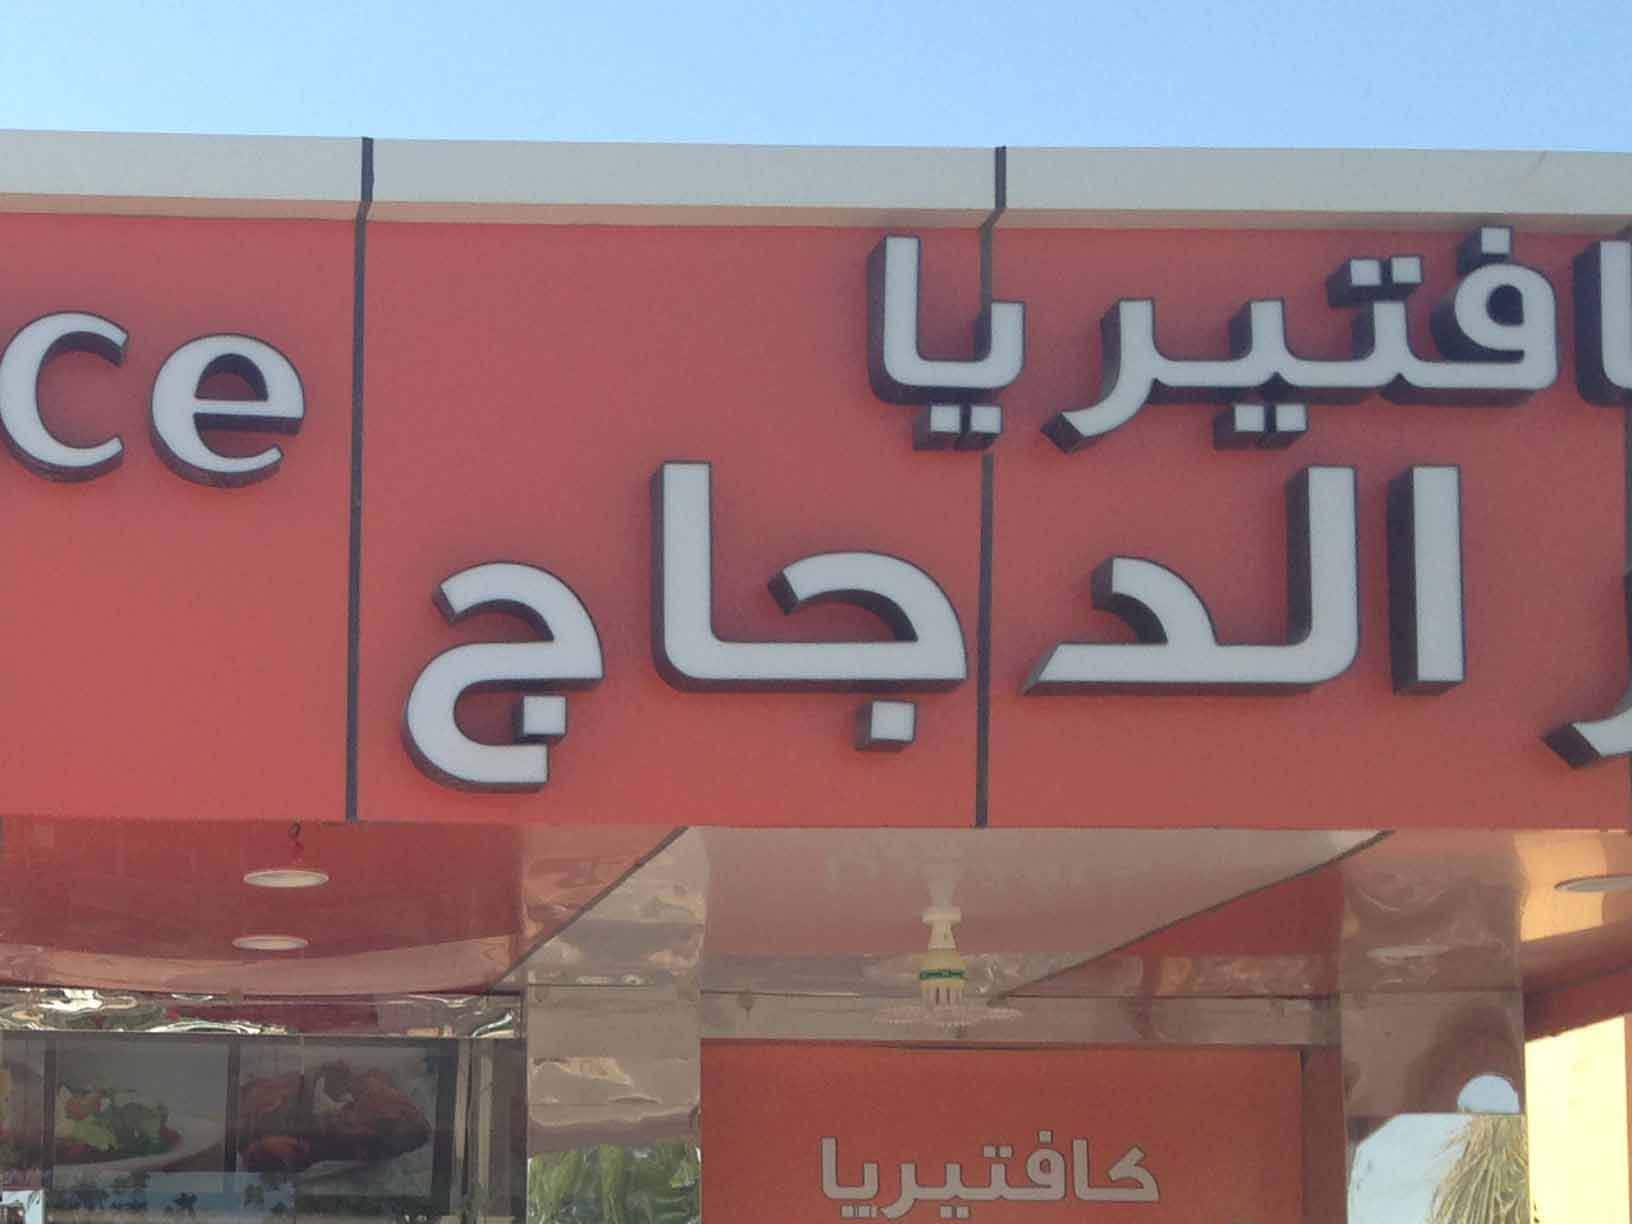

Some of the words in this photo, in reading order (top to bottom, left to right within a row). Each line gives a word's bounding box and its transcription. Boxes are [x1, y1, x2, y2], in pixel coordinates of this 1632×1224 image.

[866, 226, 1632, 453] افتيريا
[401, 460, 1464, 793] الدجاج
[819, 1130, 1161, 1219] كافتيريا
